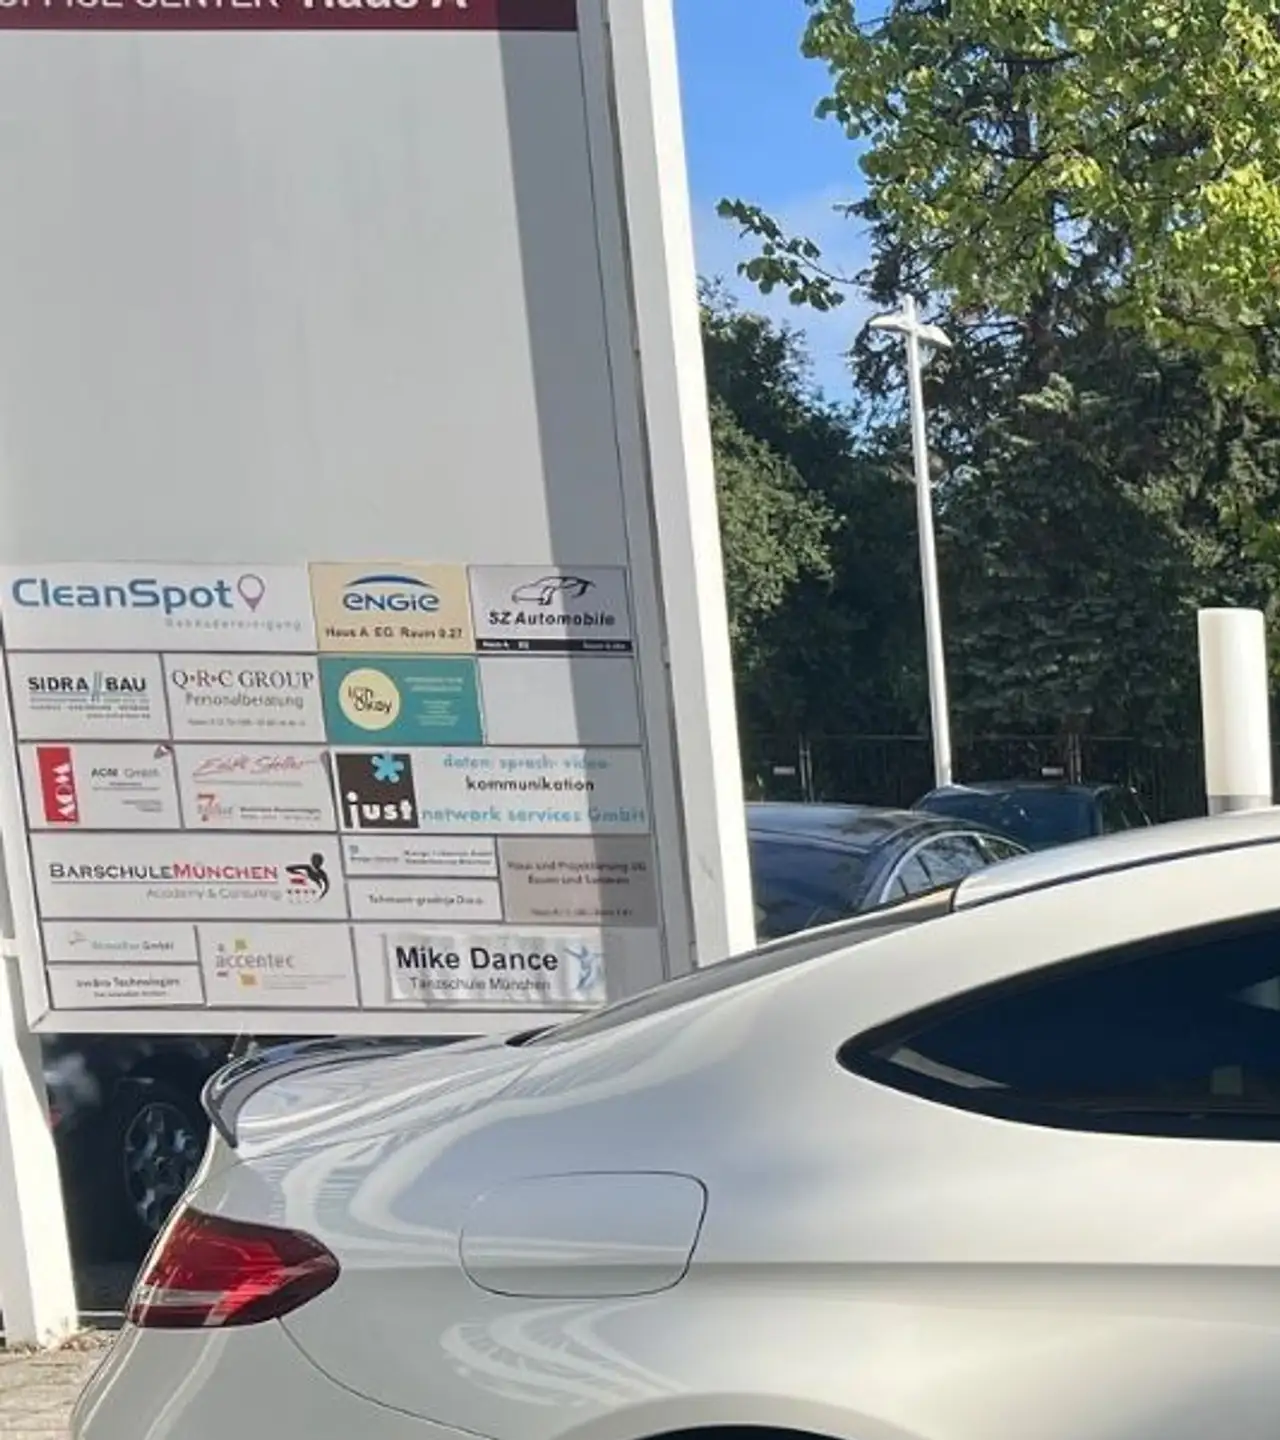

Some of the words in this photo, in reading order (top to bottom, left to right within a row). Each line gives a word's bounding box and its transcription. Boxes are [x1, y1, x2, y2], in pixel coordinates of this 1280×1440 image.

[11, 578, 234, 614] CleanSpot
[489, 611, 510, 626] SZ
[515, 611, 616, 627] Automobile
[28, 676, 90, 692] SIDRA
[105, 676, 147, 692] BAU
[237, 670, 314, 688] GROUP
[185, 692, 304, 710] Personalberatung
[466, 776, 595, 791] kommunikation
[347, 791, 413, 828] just
[422, 805, 499, 821] network
[509, 807, 582, 822] services
[215, 952, 295, 969] accentec
[395, 946, 460, 969] Mike
[470, 947, 559, 970] Dance
[410, 977, 485, 990] Tanzschule
[490, 977, 551, 990] München
